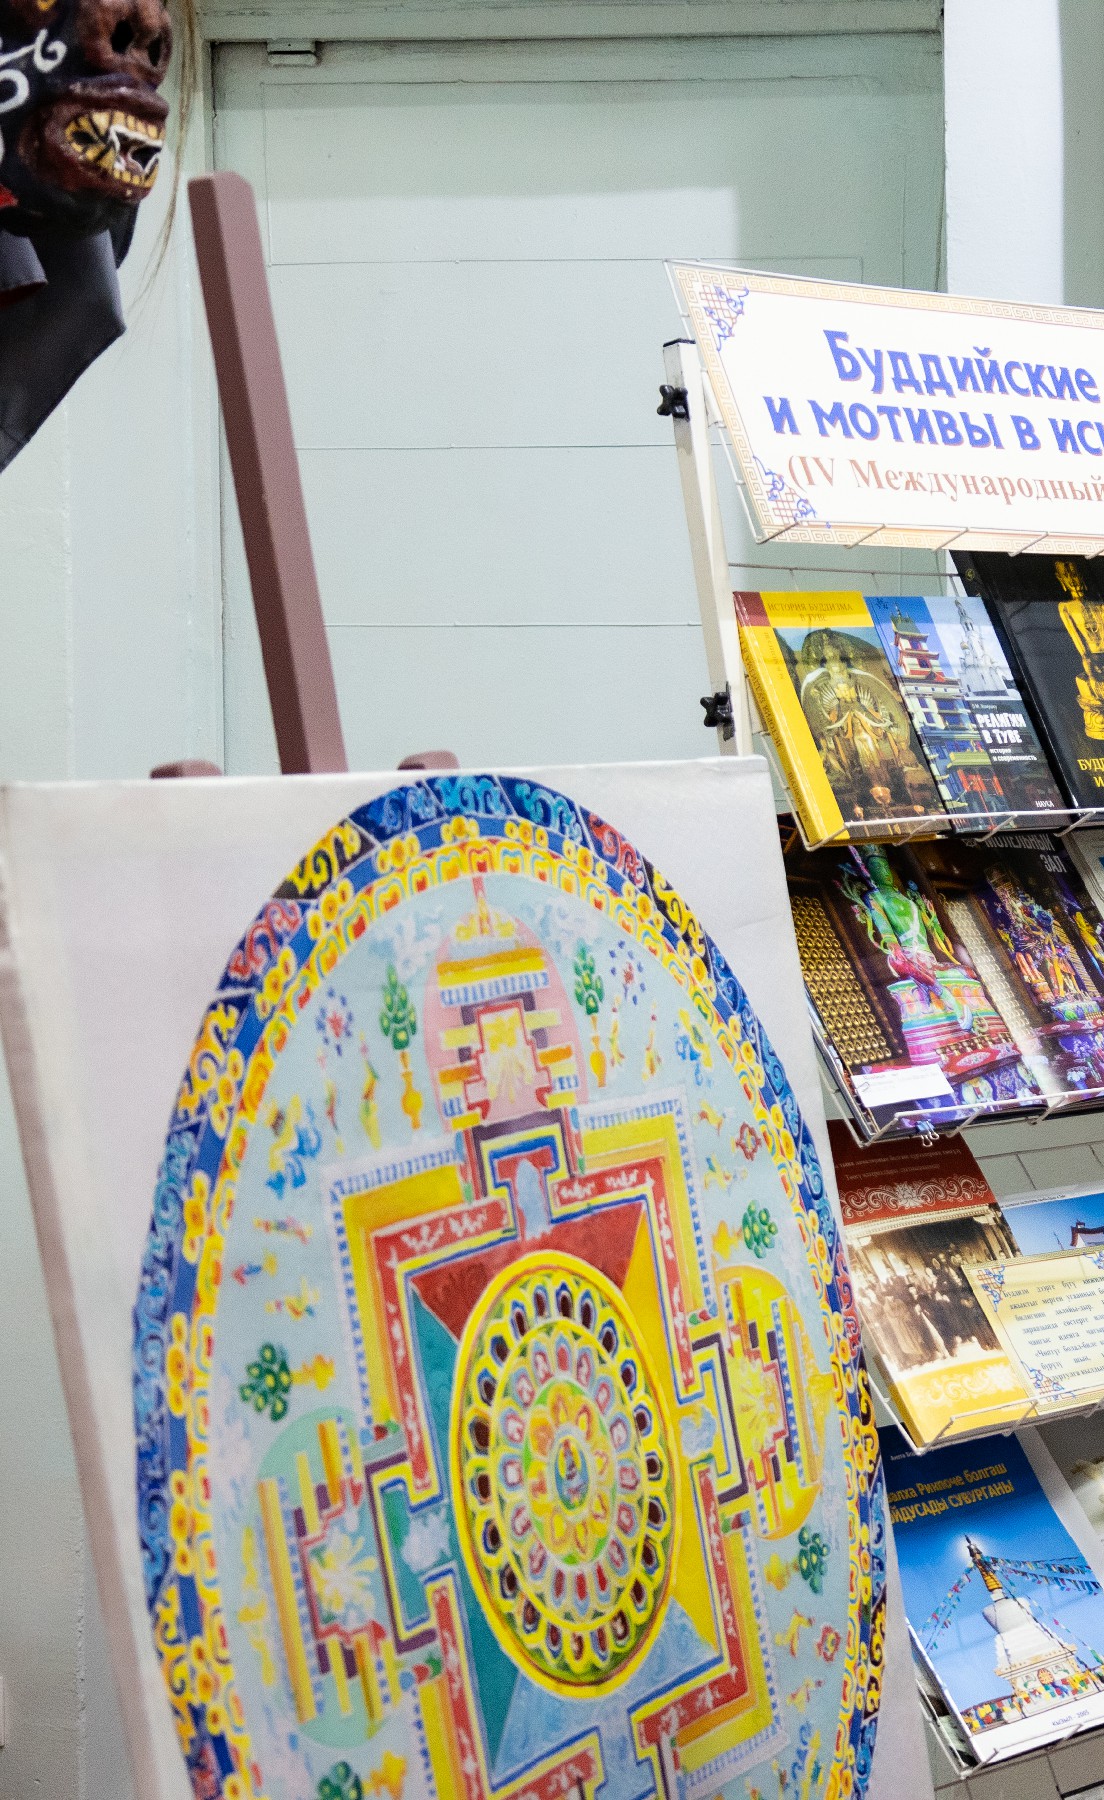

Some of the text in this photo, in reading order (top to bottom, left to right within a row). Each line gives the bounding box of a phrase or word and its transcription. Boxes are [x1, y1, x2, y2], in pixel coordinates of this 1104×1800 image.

[823, 329, 1101, 404] Буддийские
[762, 396, 802, 436] и
[807, 399, 1005, 450] мотивы
[1010, 414, 1042, 451] в
[787, 455, 835, 492] (IV
[767, 603, 854, 612] ИСТОРИЯ БУДДИЗМА
[974, 713, 1027, 728] РЕЛИГИИ
[981, 729, 1022, 744] В ТУВЕ
[1093, 776, 1104, 788] И
[1040, 854, 1067, 873] ЗАЛ
[963, 1463, 1008, 1483] болгаш
[948, 1479, 1014, 1508] СУВУРГАНЫ
